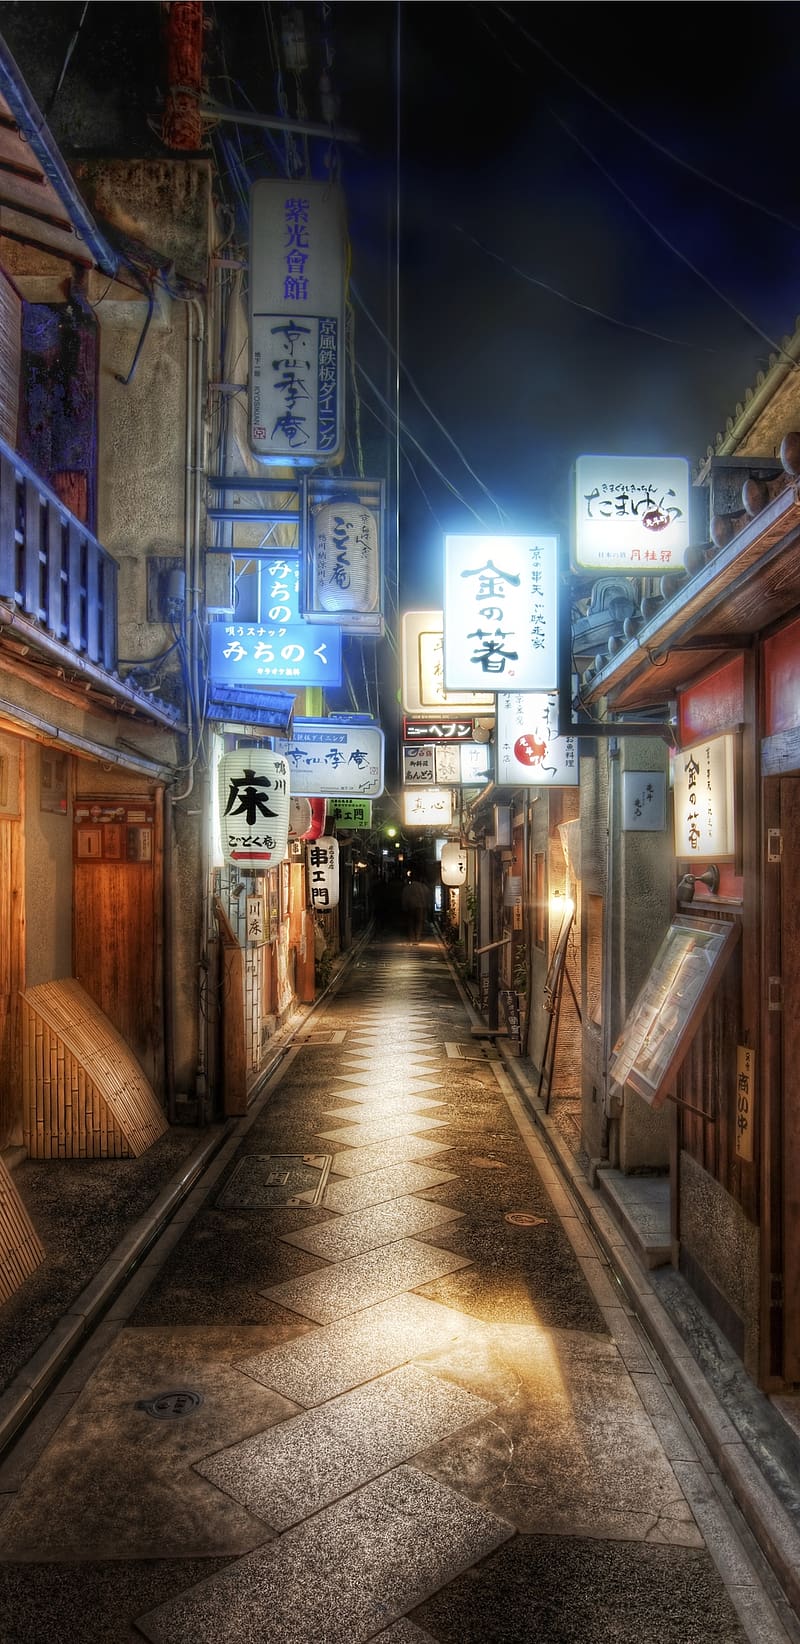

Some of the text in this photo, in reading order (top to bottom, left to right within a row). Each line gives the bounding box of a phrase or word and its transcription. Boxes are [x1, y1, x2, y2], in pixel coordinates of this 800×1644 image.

[283, 198, 310, 300] 紫光會館
[271, 320, 311, 448] 京四季庵
[319, 320, 337, 449] 京風鉄板ダイニング
[584, 487, 683, 521] たまゆら
[602, 483, 658, 493] きまぐれきっちん
[328, 516, 354, 590] ごとく庵
[630, 549, 672, 563] 月桂冠
[225, 626, 287, 637] 唄うスナック
[223, 640, 328, 664] みちのく
[285, 747, 370, 770] 京四季庵
[273, 760, 287, 796] 鴨川
[223, 769, 280, 826] 床
[228, 835, 277, 850] ごとく庵
[249, 901, 262, 936] 川床
